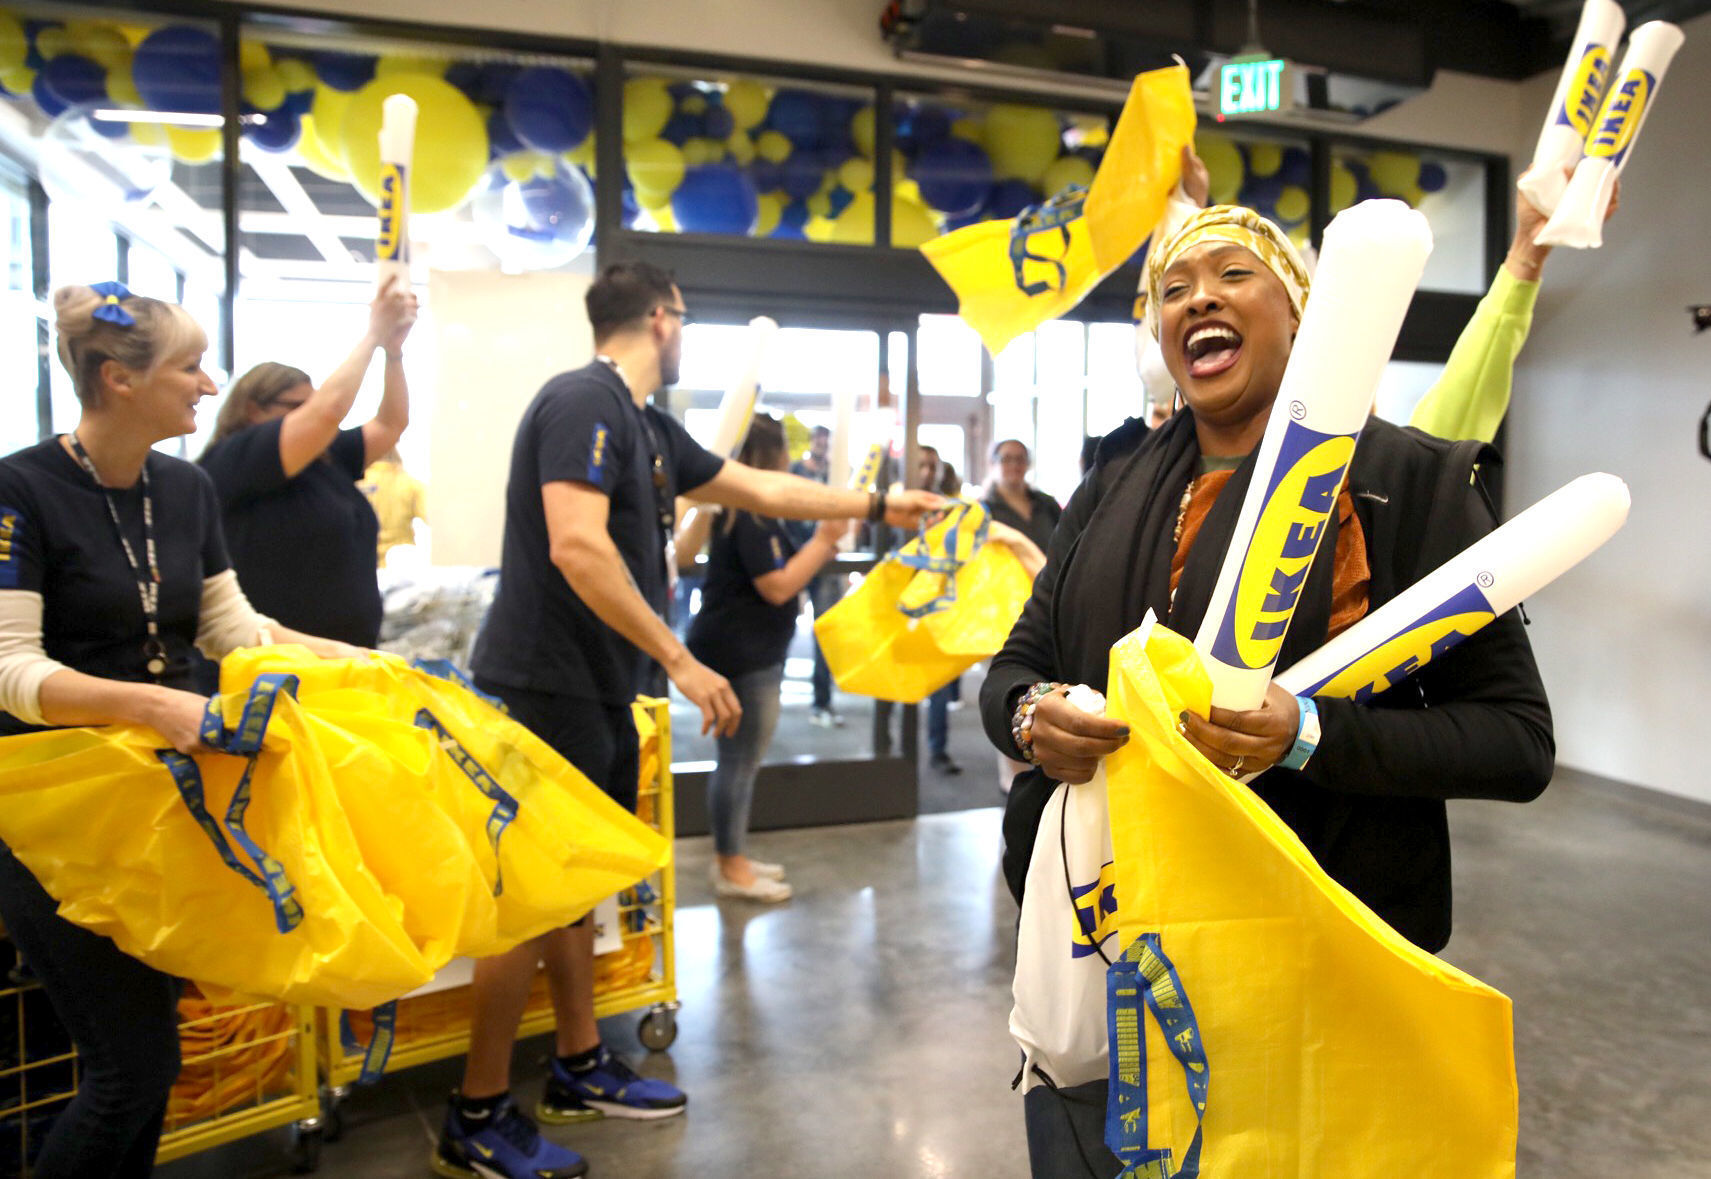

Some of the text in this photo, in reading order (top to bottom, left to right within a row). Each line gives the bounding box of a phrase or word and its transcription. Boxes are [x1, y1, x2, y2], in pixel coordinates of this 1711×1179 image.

[1220, 59, 1285, 114] EXIT
[1576, 57, 1608, 124] IKEA
[1592, 79, 1641, 146] IKEA
[380, 175, 394, 246] IKEA
[1250, 462, 1348, 641] IKEA
